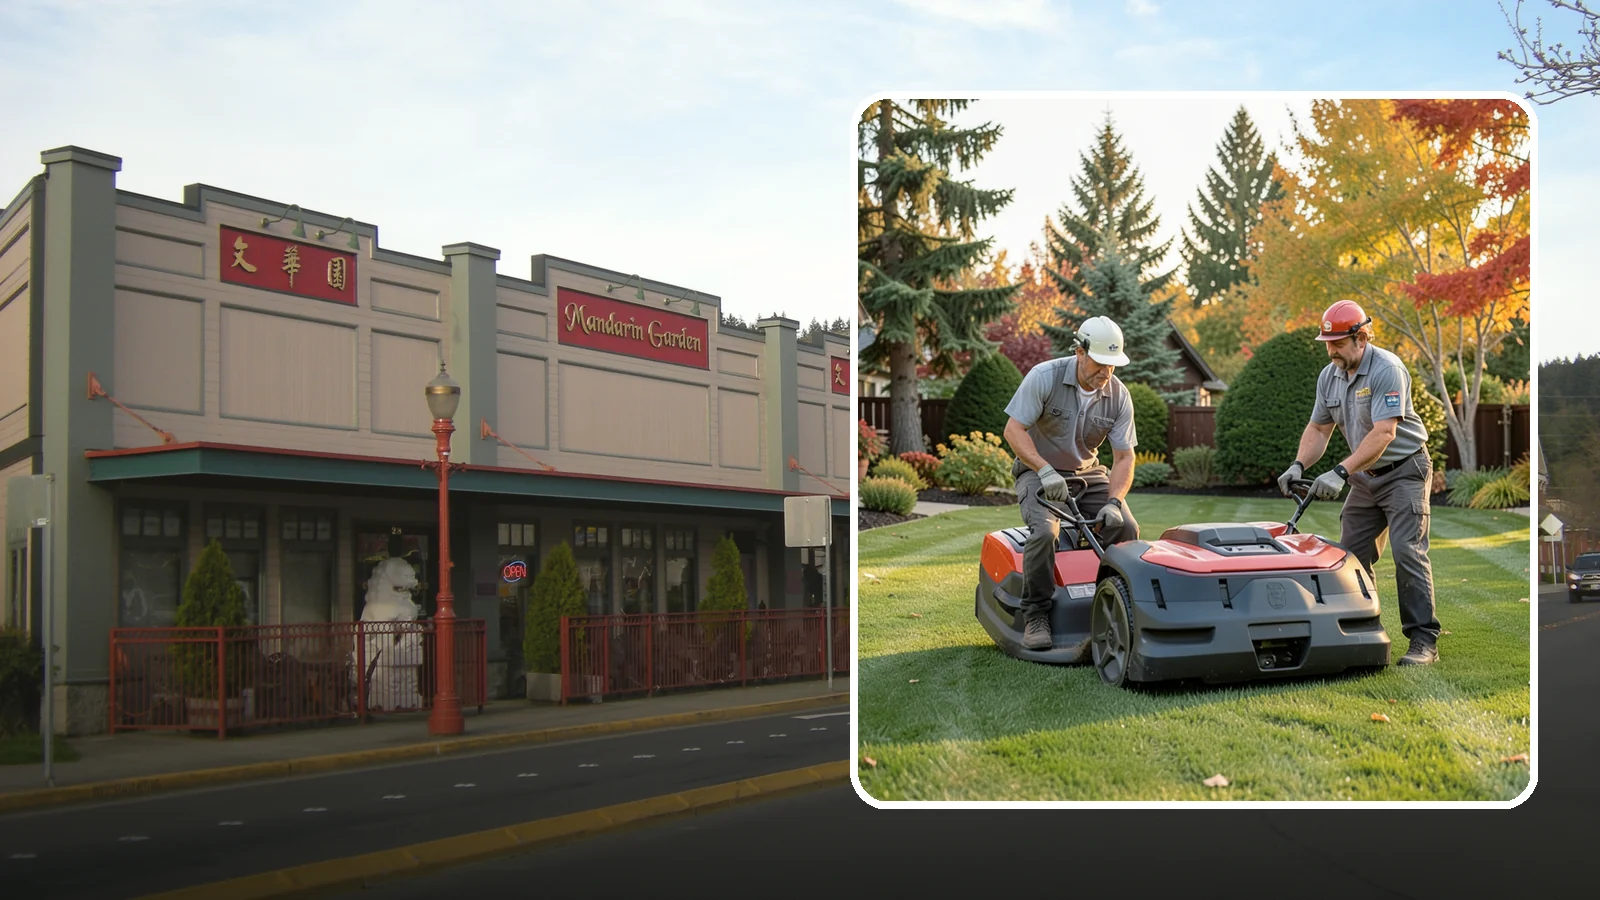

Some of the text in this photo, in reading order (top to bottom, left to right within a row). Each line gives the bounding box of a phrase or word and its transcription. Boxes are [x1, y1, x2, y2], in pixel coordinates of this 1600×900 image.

[230, 235, 347, 291] 文華園
[564, 302, 702, 352] Mandarin Garden
[503, 565, 527, 578] OPEN
